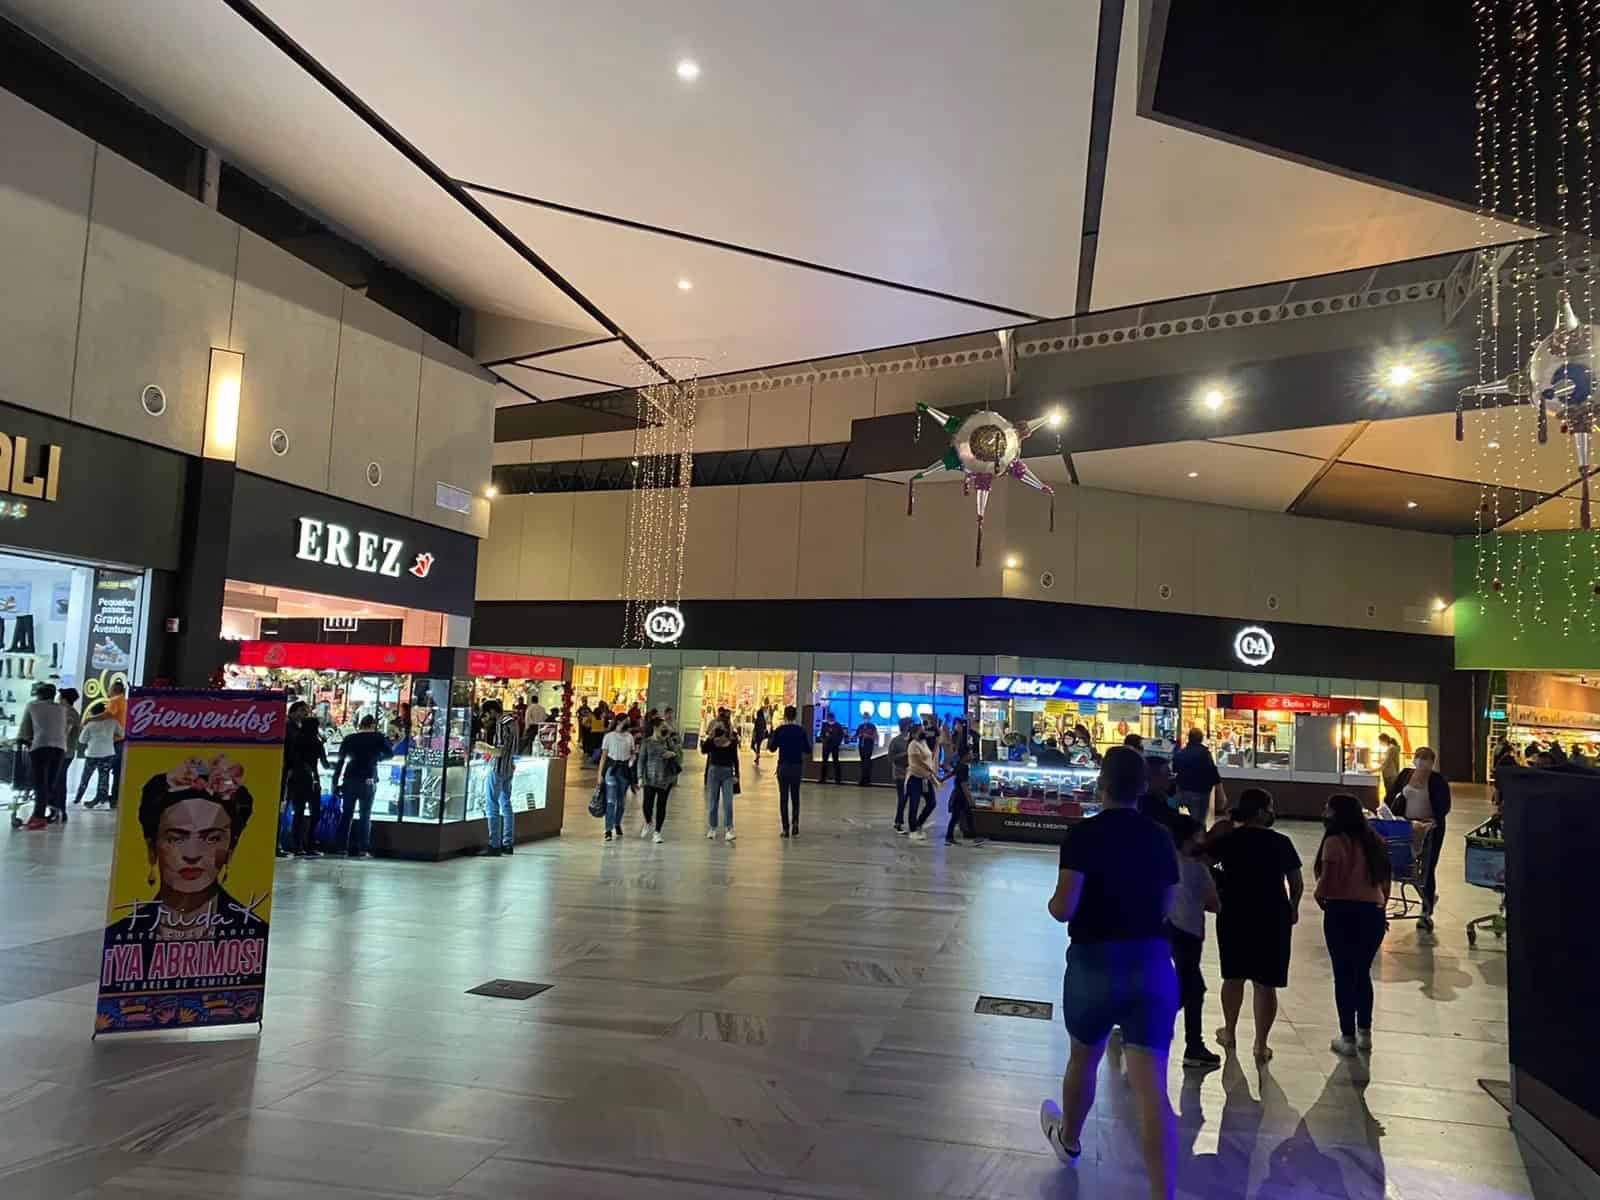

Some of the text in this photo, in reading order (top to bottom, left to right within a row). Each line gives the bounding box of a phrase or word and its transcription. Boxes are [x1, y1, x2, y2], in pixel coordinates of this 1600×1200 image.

[296, 517, 403, 577] EREZ
[1009, 679, 1061, 695] telcel
[1093, 682, 1147, 700] telcel
[131, 699, 277, 734] Bienvenidos
[113, 898, 233, 933] Frida
[102, 937, 265, 987] ¡YA ABRIMOS!
